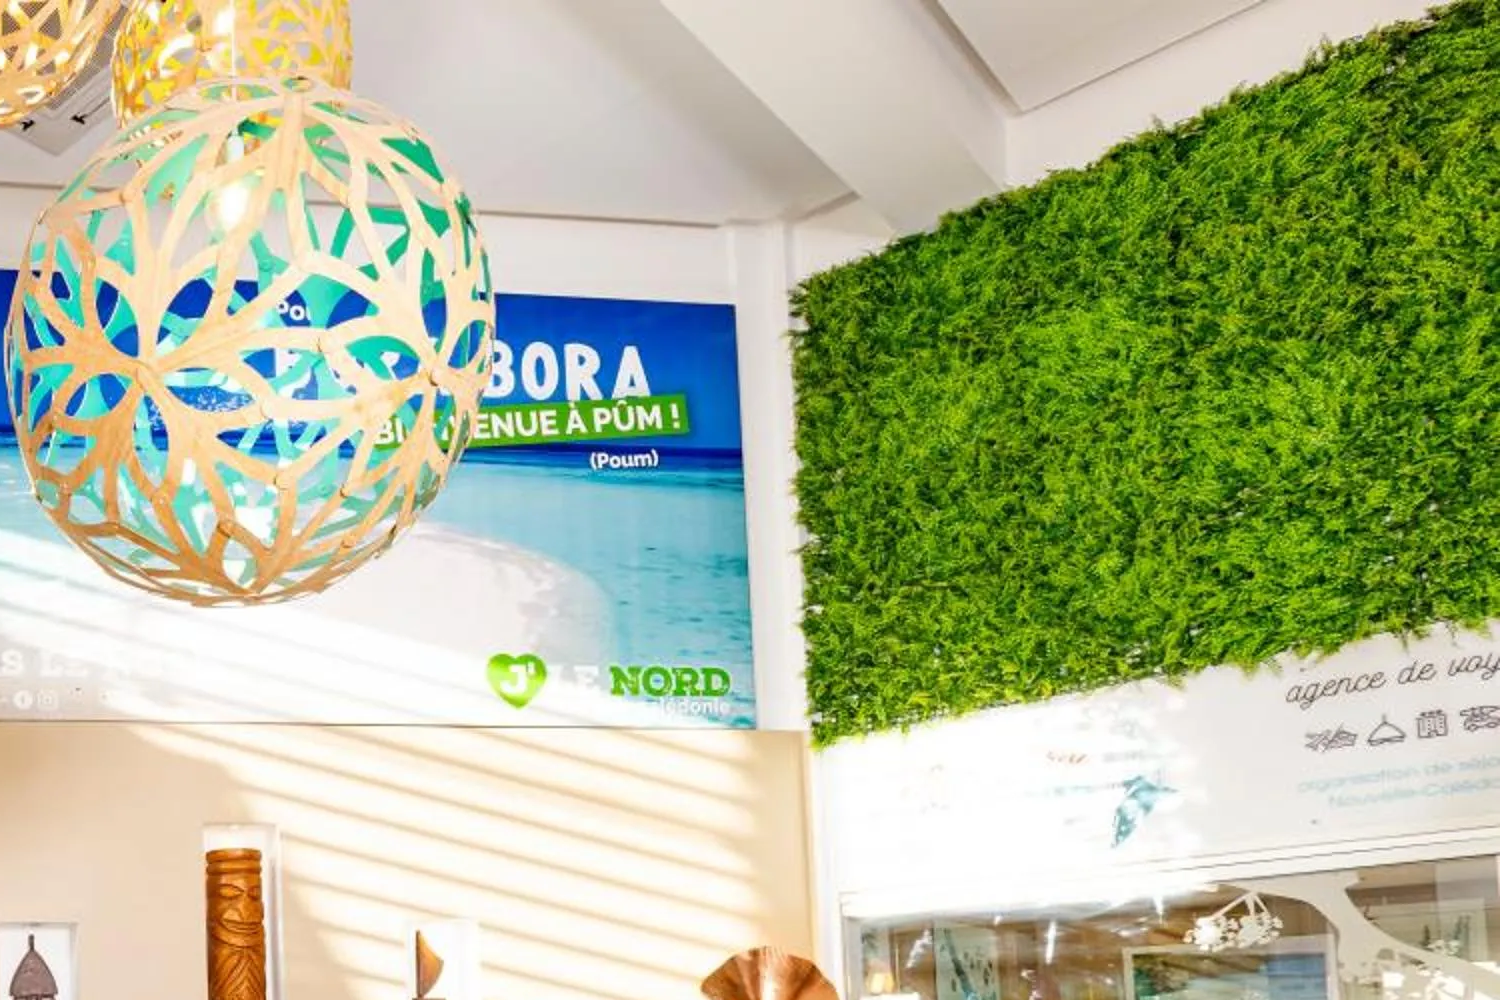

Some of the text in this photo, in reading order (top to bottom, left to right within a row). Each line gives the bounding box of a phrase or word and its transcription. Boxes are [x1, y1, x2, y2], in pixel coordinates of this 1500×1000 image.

[374, 399, 681, 444] BIENUE À PÛM !
[589, 448, 659, 471] (Poum)
[609, 665, 732, 698] NORD
[1285, 652, 1500, 711] agence de voy
